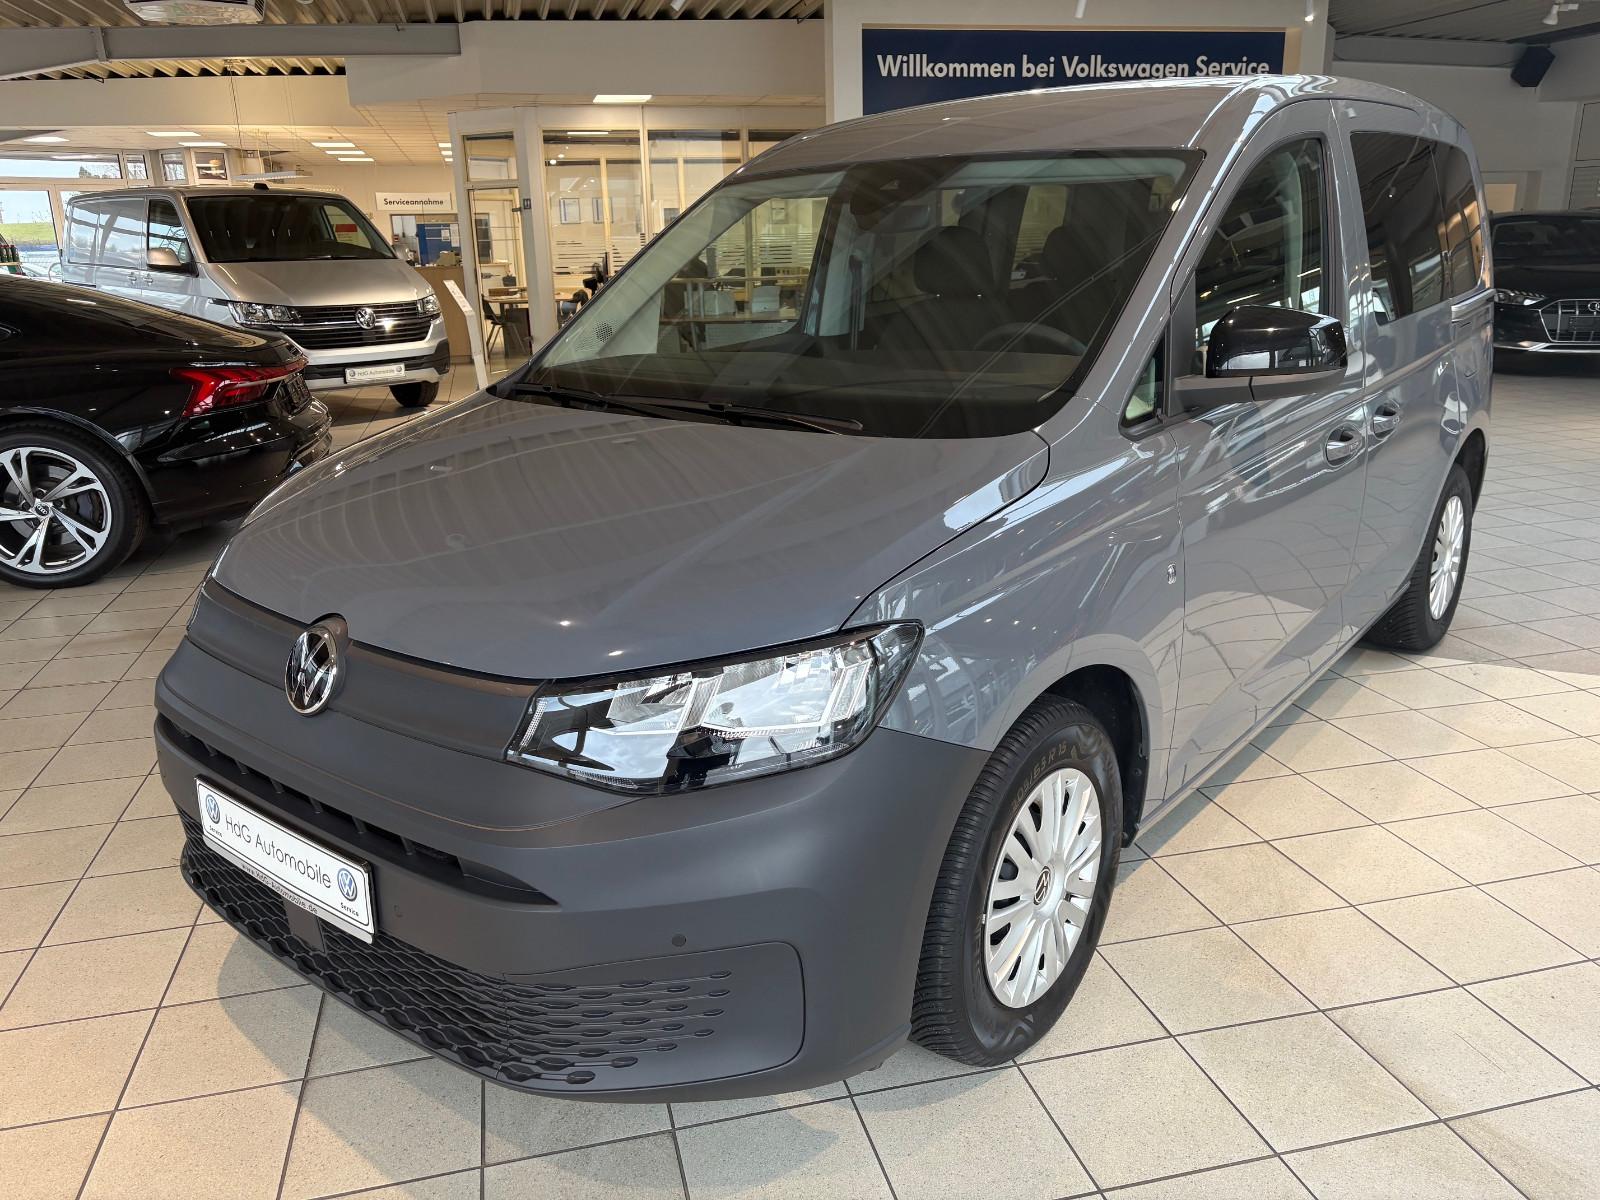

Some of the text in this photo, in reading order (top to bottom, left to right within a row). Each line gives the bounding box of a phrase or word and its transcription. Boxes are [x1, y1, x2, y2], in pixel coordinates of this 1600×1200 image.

[877, 53, 1270, 79] Willkommen bei Volkswagen Service
[383, 197, 444, 206] Serviceannahme
[225, 814, 331, 889] HdG Automobile
[340, 901, 360, 917] Service
